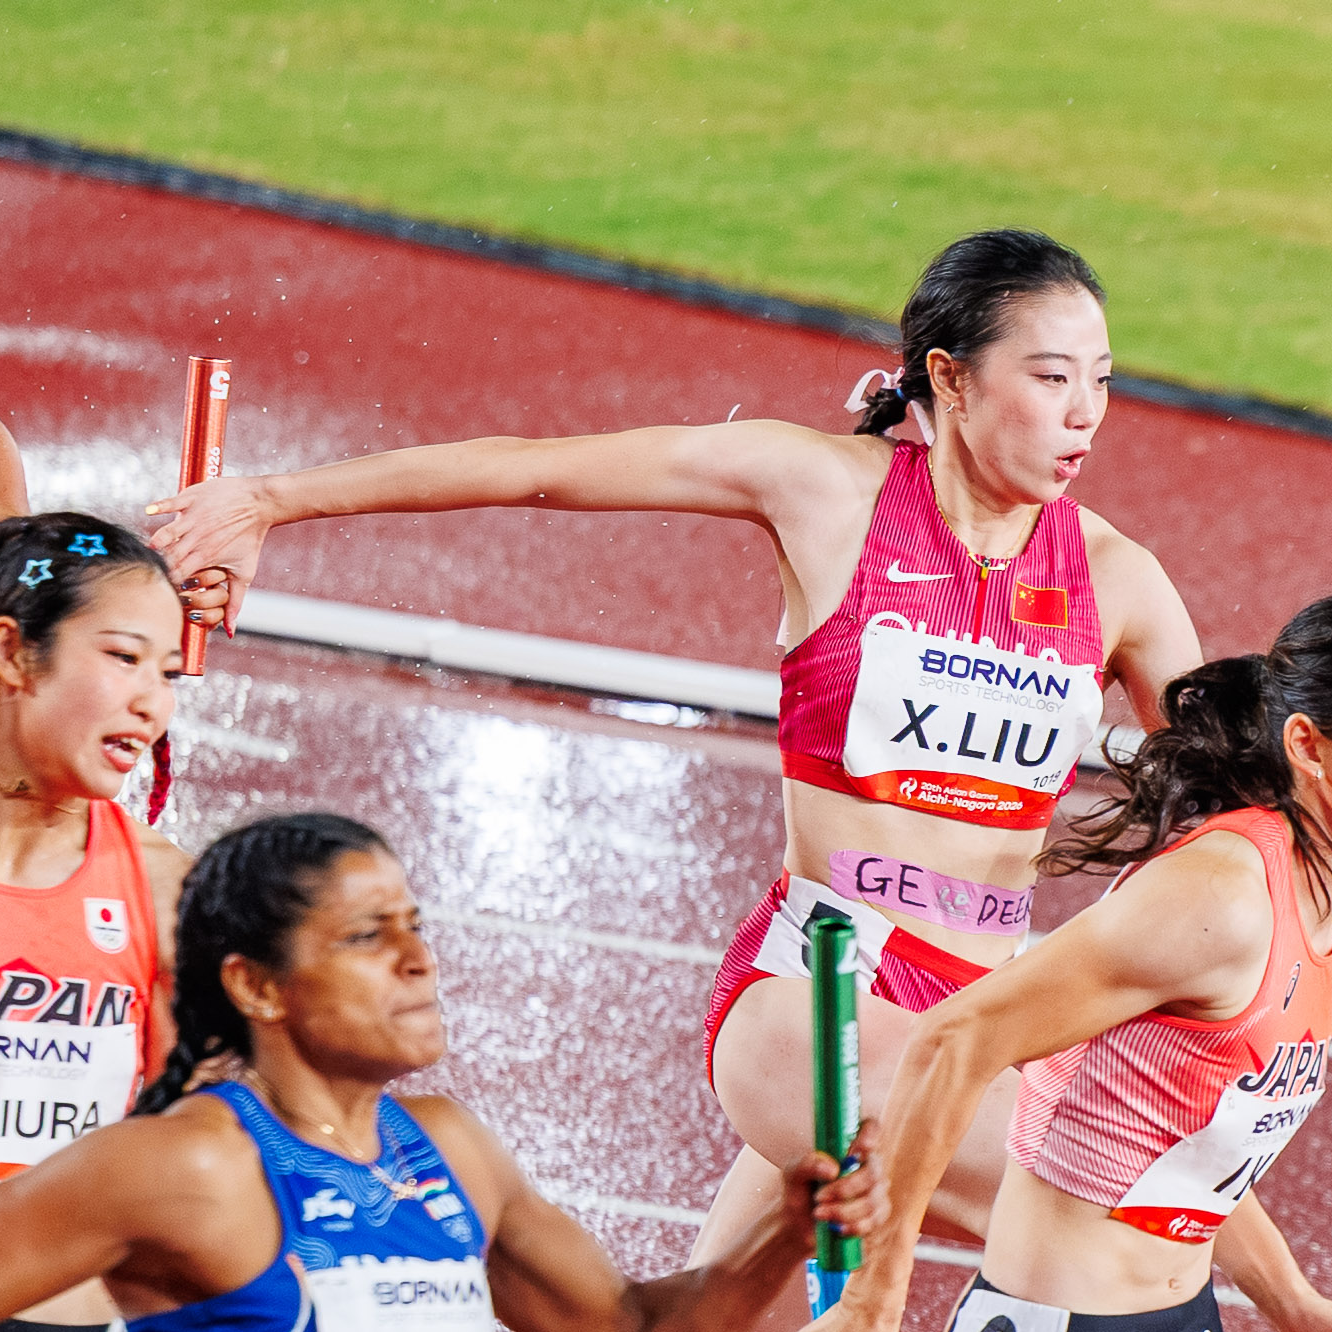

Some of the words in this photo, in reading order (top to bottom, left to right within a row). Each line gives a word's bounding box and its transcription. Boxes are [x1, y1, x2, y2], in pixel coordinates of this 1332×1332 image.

[209, 370, 231, 400] 5
[918, 648, 1071, 700] BORNAN
[918, 675, 970, 696] SPORTS
[975, 686, 1065, 714] TECHNOLOGY
[889, 698, 1060, 768] X.LIU
[920, 781, 943, 793] 20th
[942, 785, 968, 798] Asian
[968, 789, 999, 800] Games
[1032, 770, 1063, 789] 1019
[917, 790, 996, 812] Aichi-Nagoya
[996, 800, 1024, 811] 2026
[854, 856, 928, 909] GE
[1236, 1042, 1327, 1099] JAPA
